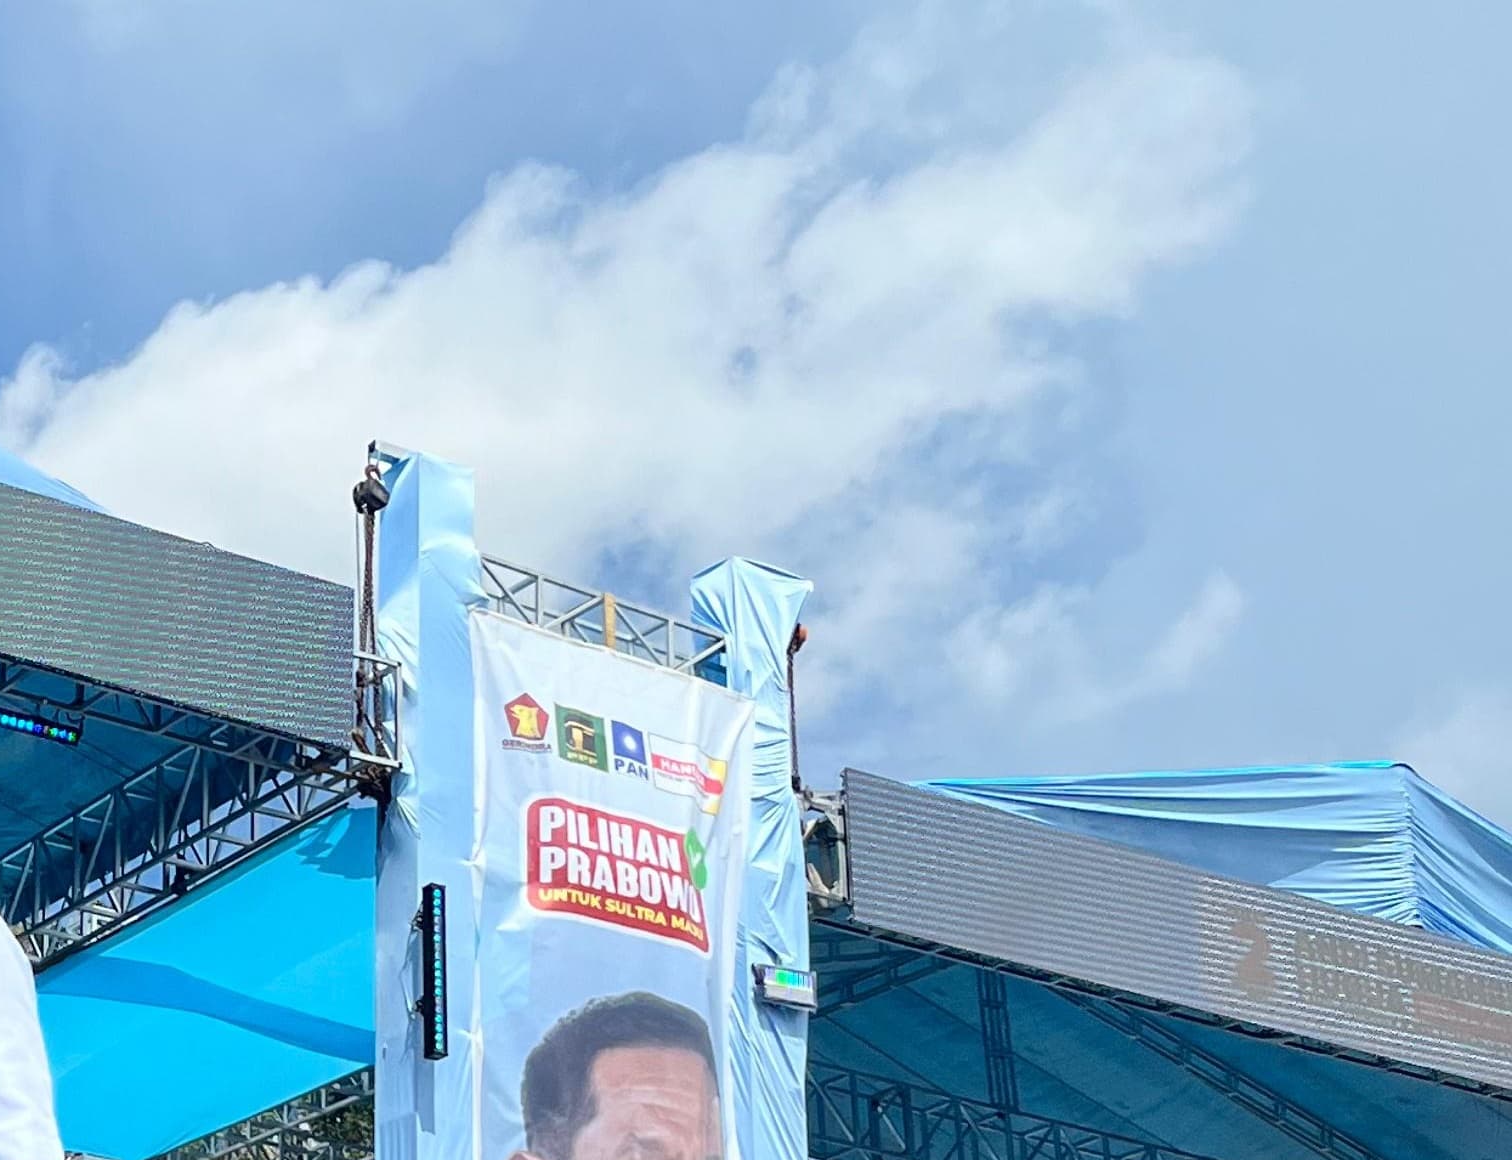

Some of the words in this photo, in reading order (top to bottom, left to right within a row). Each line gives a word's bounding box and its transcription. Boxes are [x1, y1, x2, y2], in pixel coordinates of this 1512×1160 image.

[614, 757, 649, 781] PAN
[539, 805, 682, 873] PILIHAN
[539, 887, 603, 910] UNTUK
[604, 898, 667, 928] SULTRA
